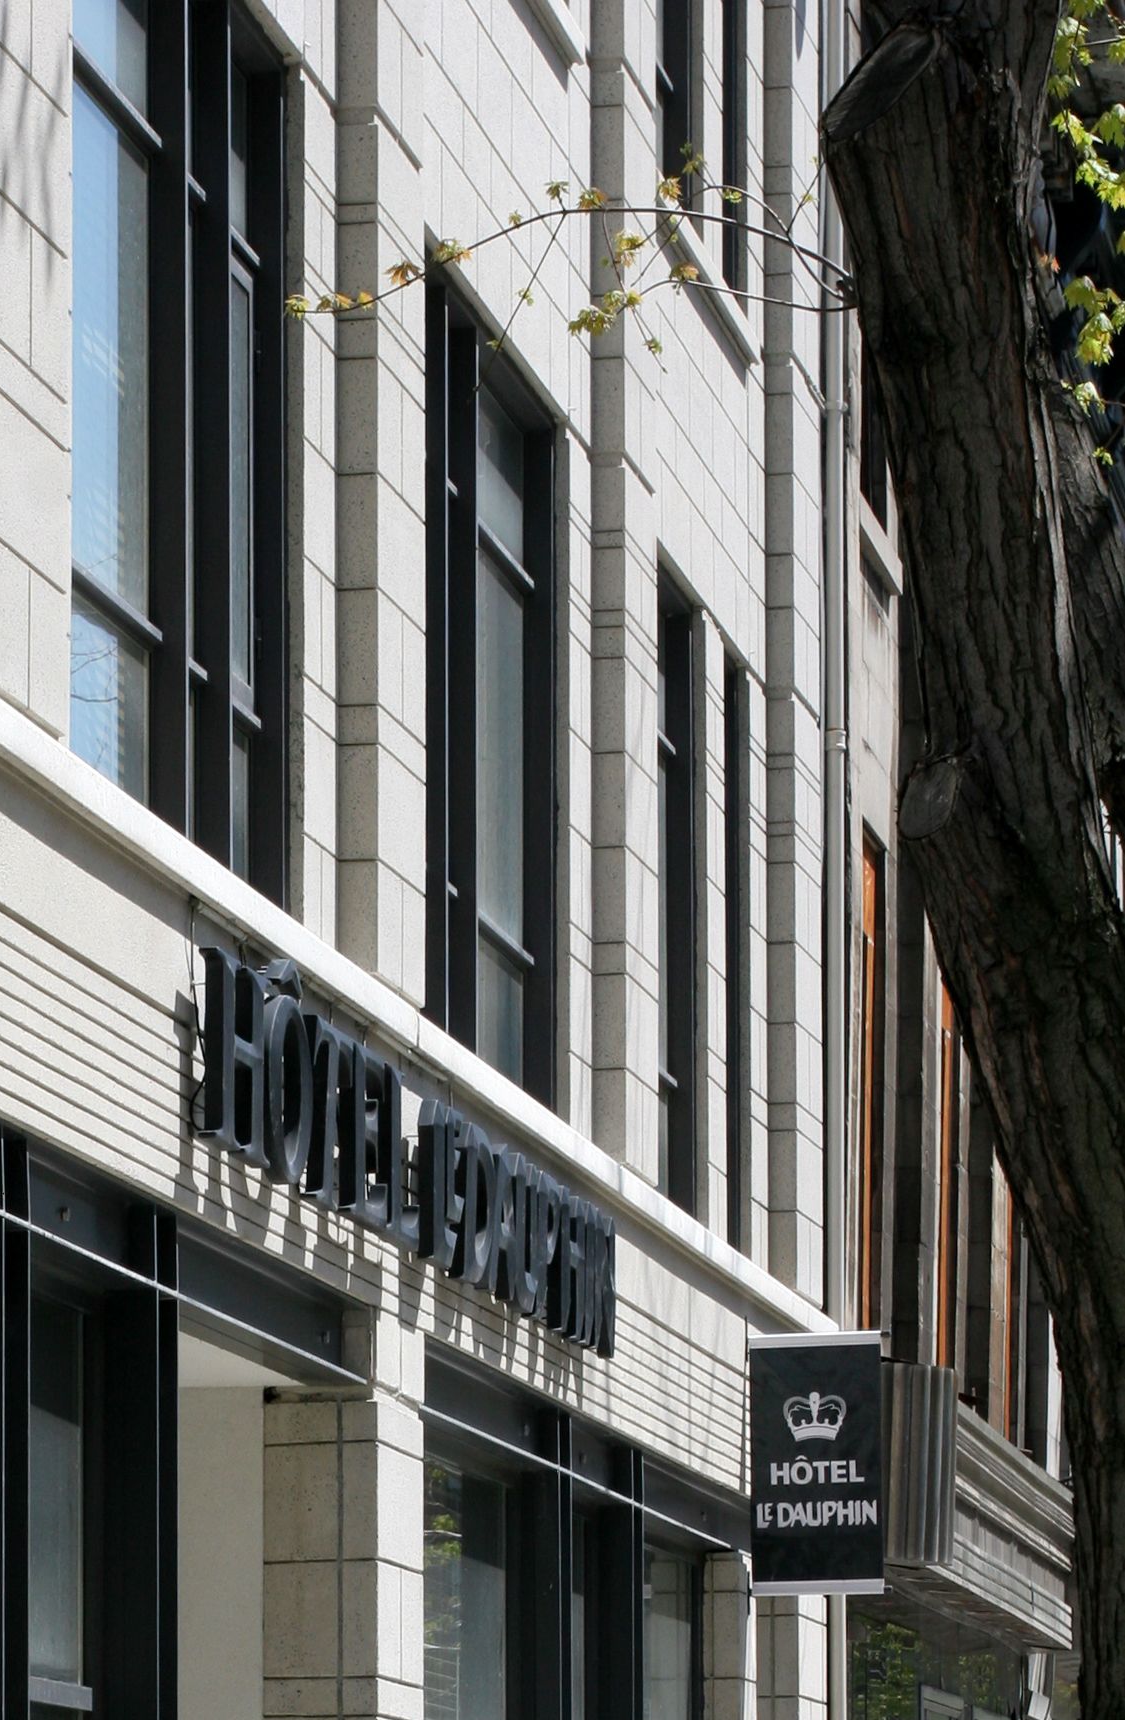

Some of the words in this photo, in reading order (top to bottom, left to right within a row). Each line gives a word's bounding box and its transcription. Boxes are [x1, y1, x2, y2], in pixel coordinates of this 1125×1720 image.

[198, 946, 420, 1250] HÔTEL
[769, 1454, 866, 1486] HÔTEL
[756, 1502, 774, 1529] LE
[776, 1500, 878, 1529] DAUPHIN
